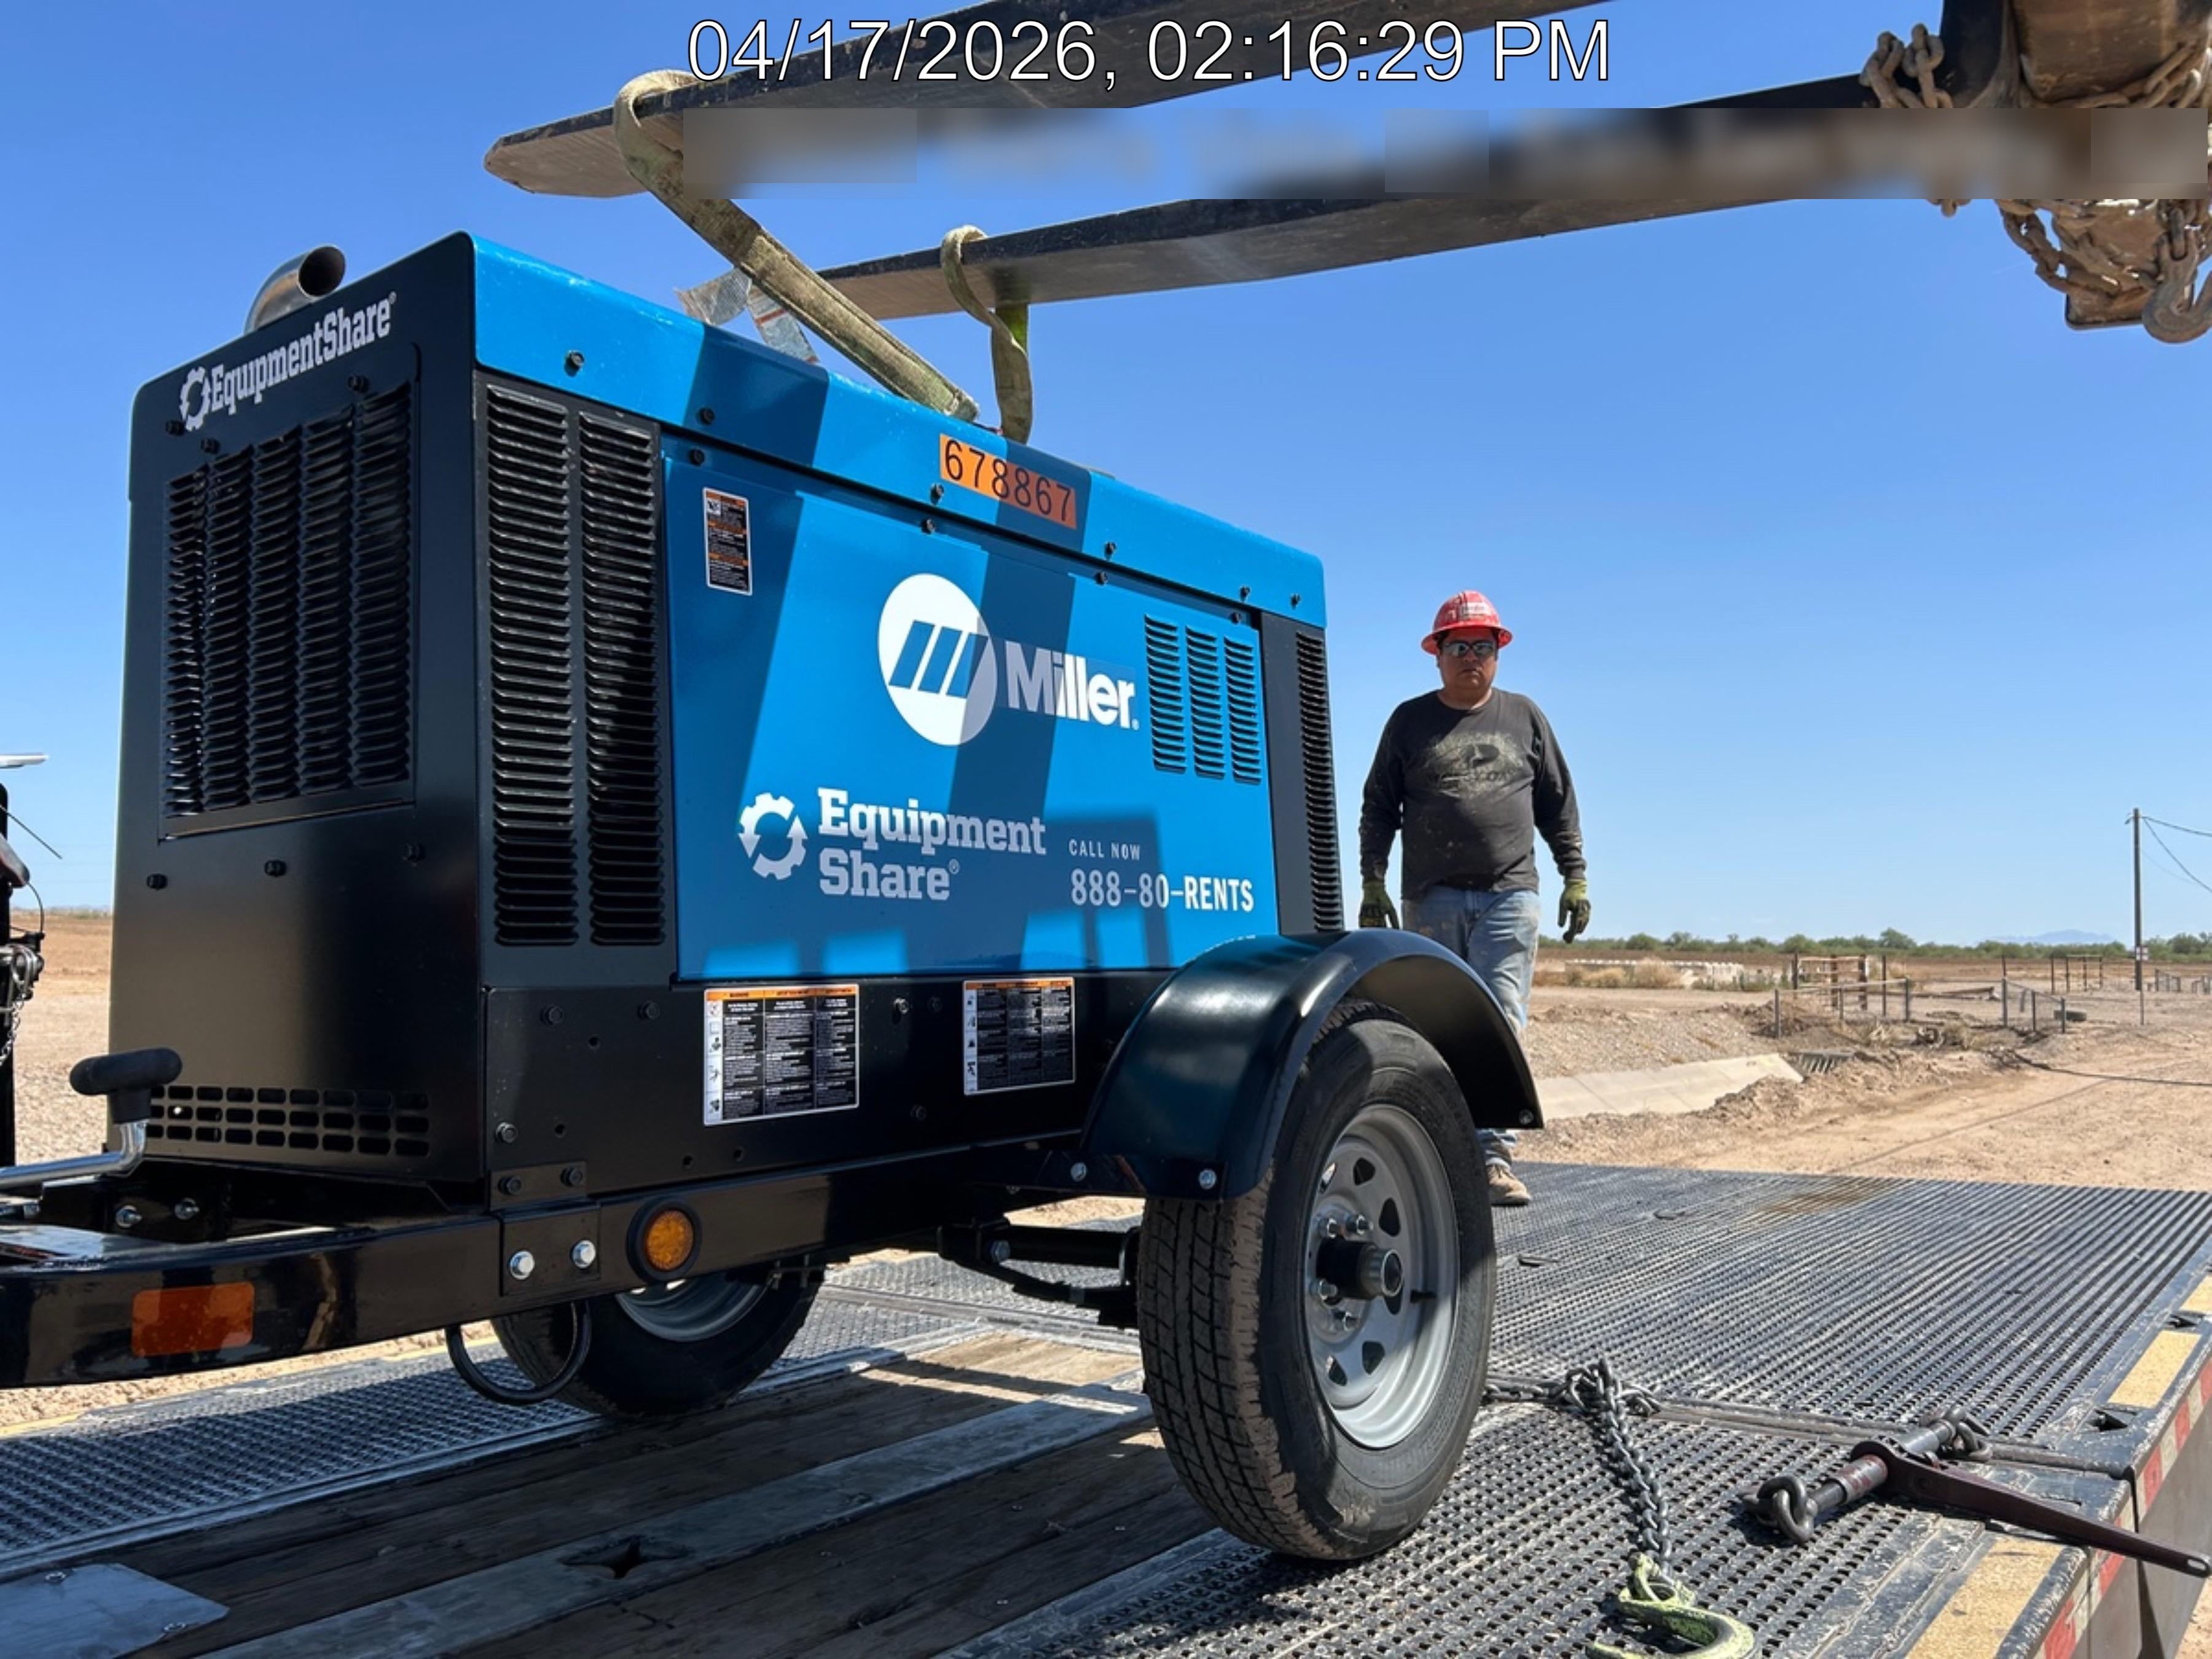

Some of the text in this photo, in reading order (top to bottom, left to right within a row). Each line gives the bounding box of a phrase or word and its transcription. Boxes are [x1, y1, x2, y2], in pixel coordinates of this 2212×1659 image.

[945, 439, 1072, 522] 678867
[818, 786, 1048, 855] Equipment
[1069, 839, 1141, 861] CALL NOW
[1070, 868, 1254, 913] 888-80-RENTS
